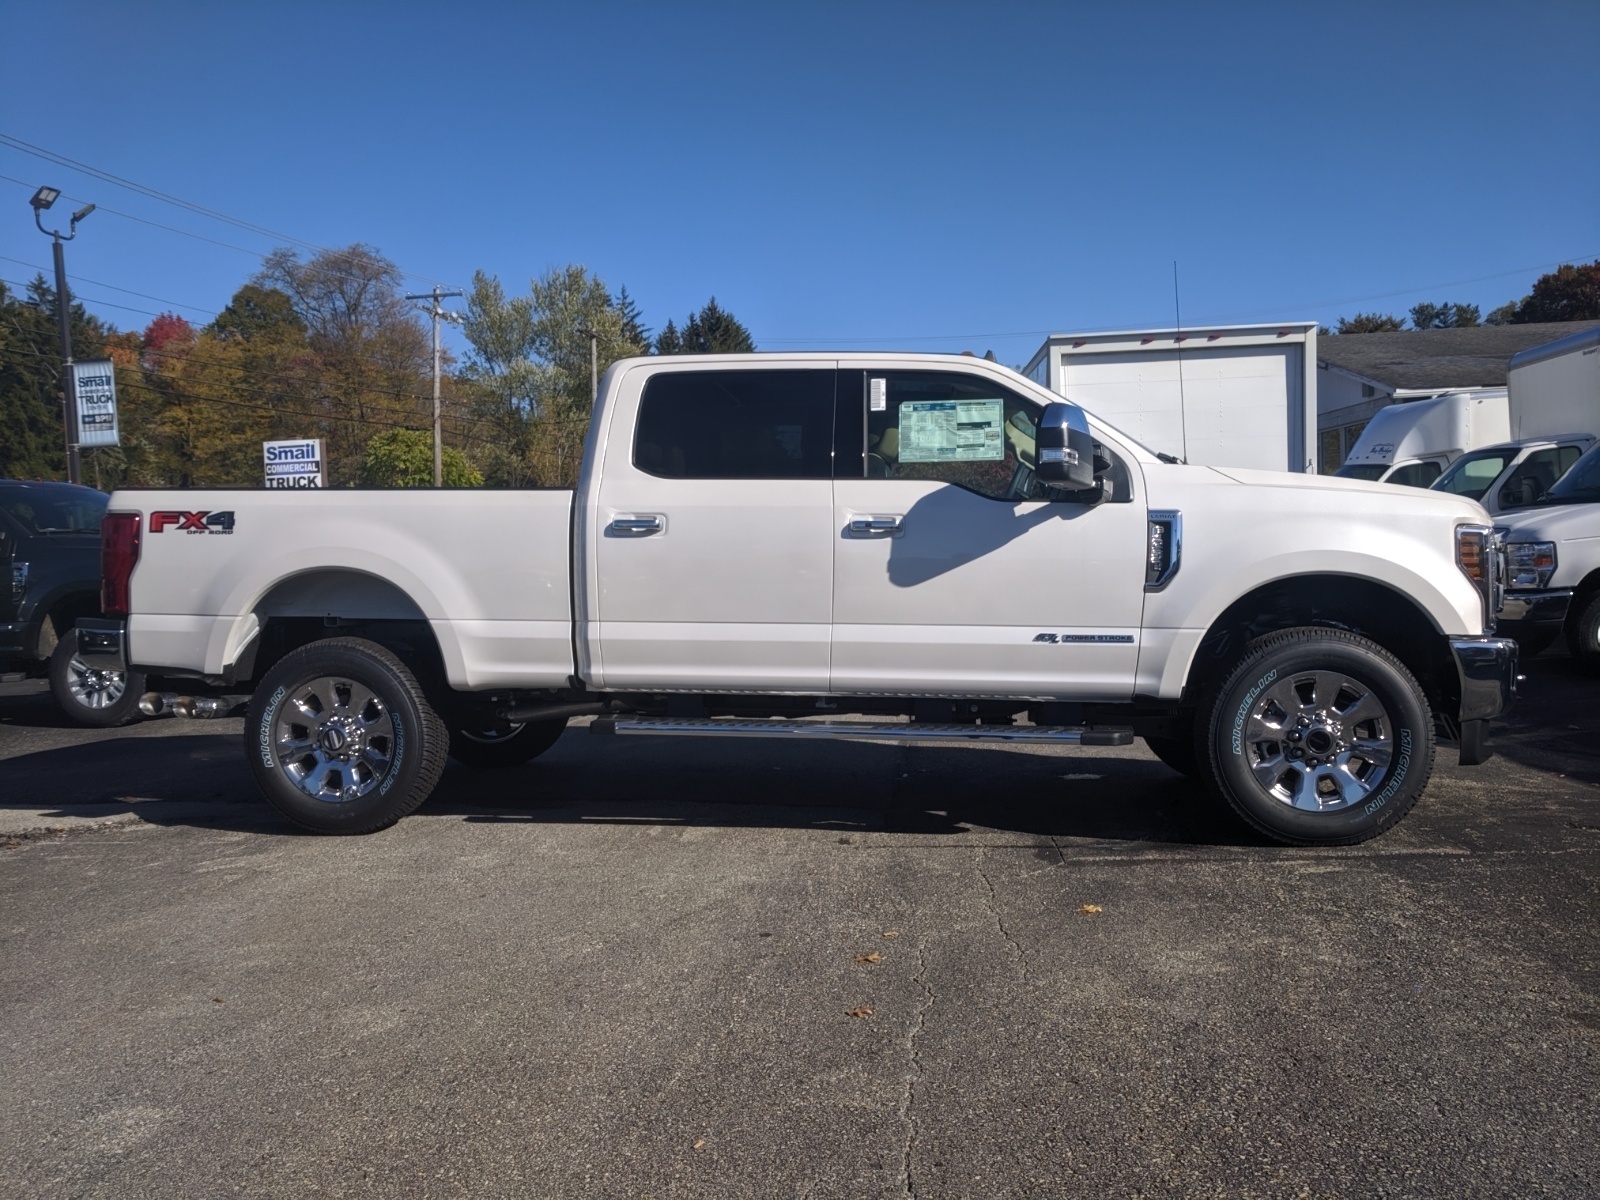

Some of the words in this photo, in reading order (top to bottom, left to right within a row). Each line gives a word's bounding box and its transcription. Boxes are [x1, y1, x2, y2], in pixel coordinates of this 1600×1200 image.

[78, 394, 114, 404] TRUCK
[266, 443, 315, 461] Smail
[266, 462, 318, 474] COMMERCIAL
[266, 475, 318, 488] TRUCK
[149, 510, 235, 533] FX4
[1232, 669, 1277, 755] MICHELIN
[260, 686, 286, 768] MICHELIN
[379, 712, 404, 795] MICHELIN
[1364, 729, 1412, 815] MICHELIN
